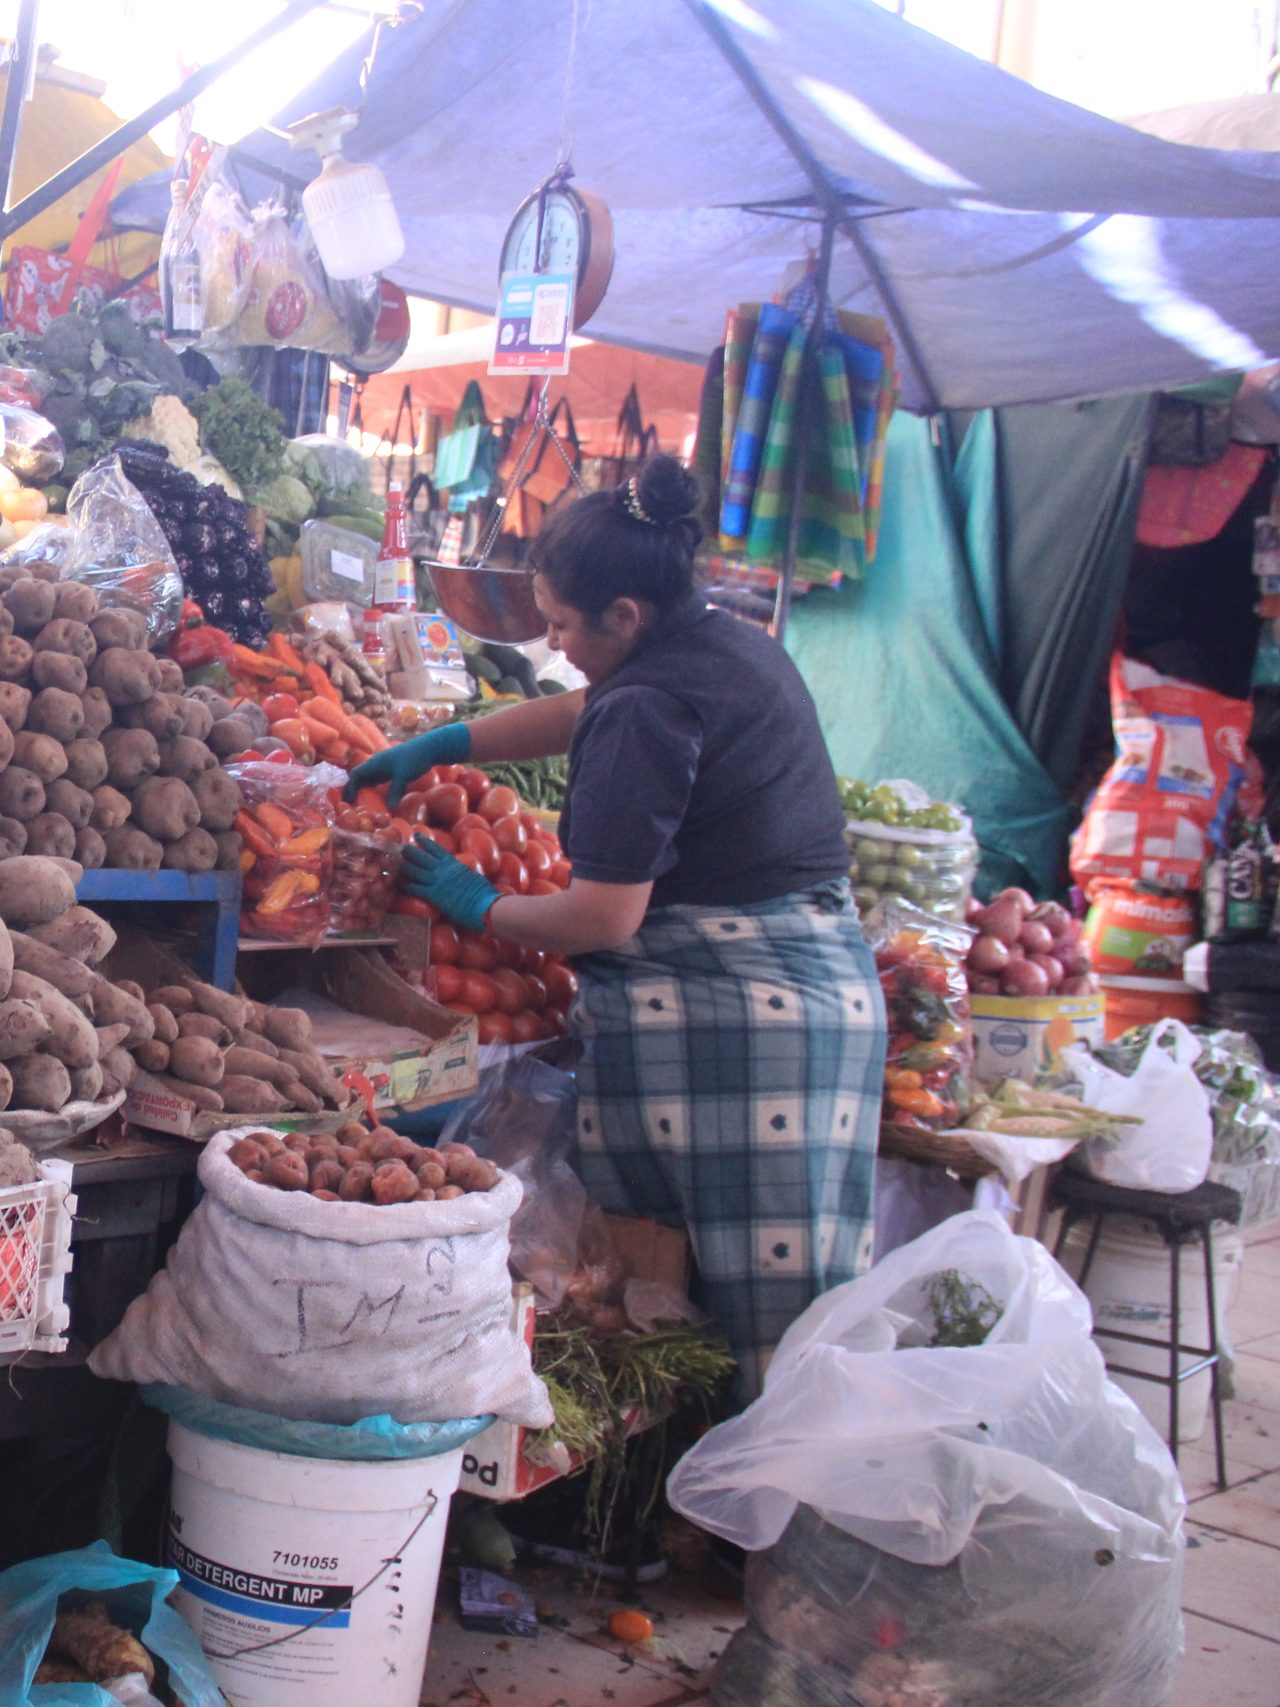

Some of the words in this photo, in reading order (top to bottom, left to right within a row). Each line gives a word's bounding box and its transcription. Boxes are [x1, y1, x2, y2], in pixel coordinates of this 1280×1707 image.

[273, 1551, 339, 1570] 7101055
[186, 1553, 288, 1600] DETERGENT
[292, 1586, 324, 1604] MP
